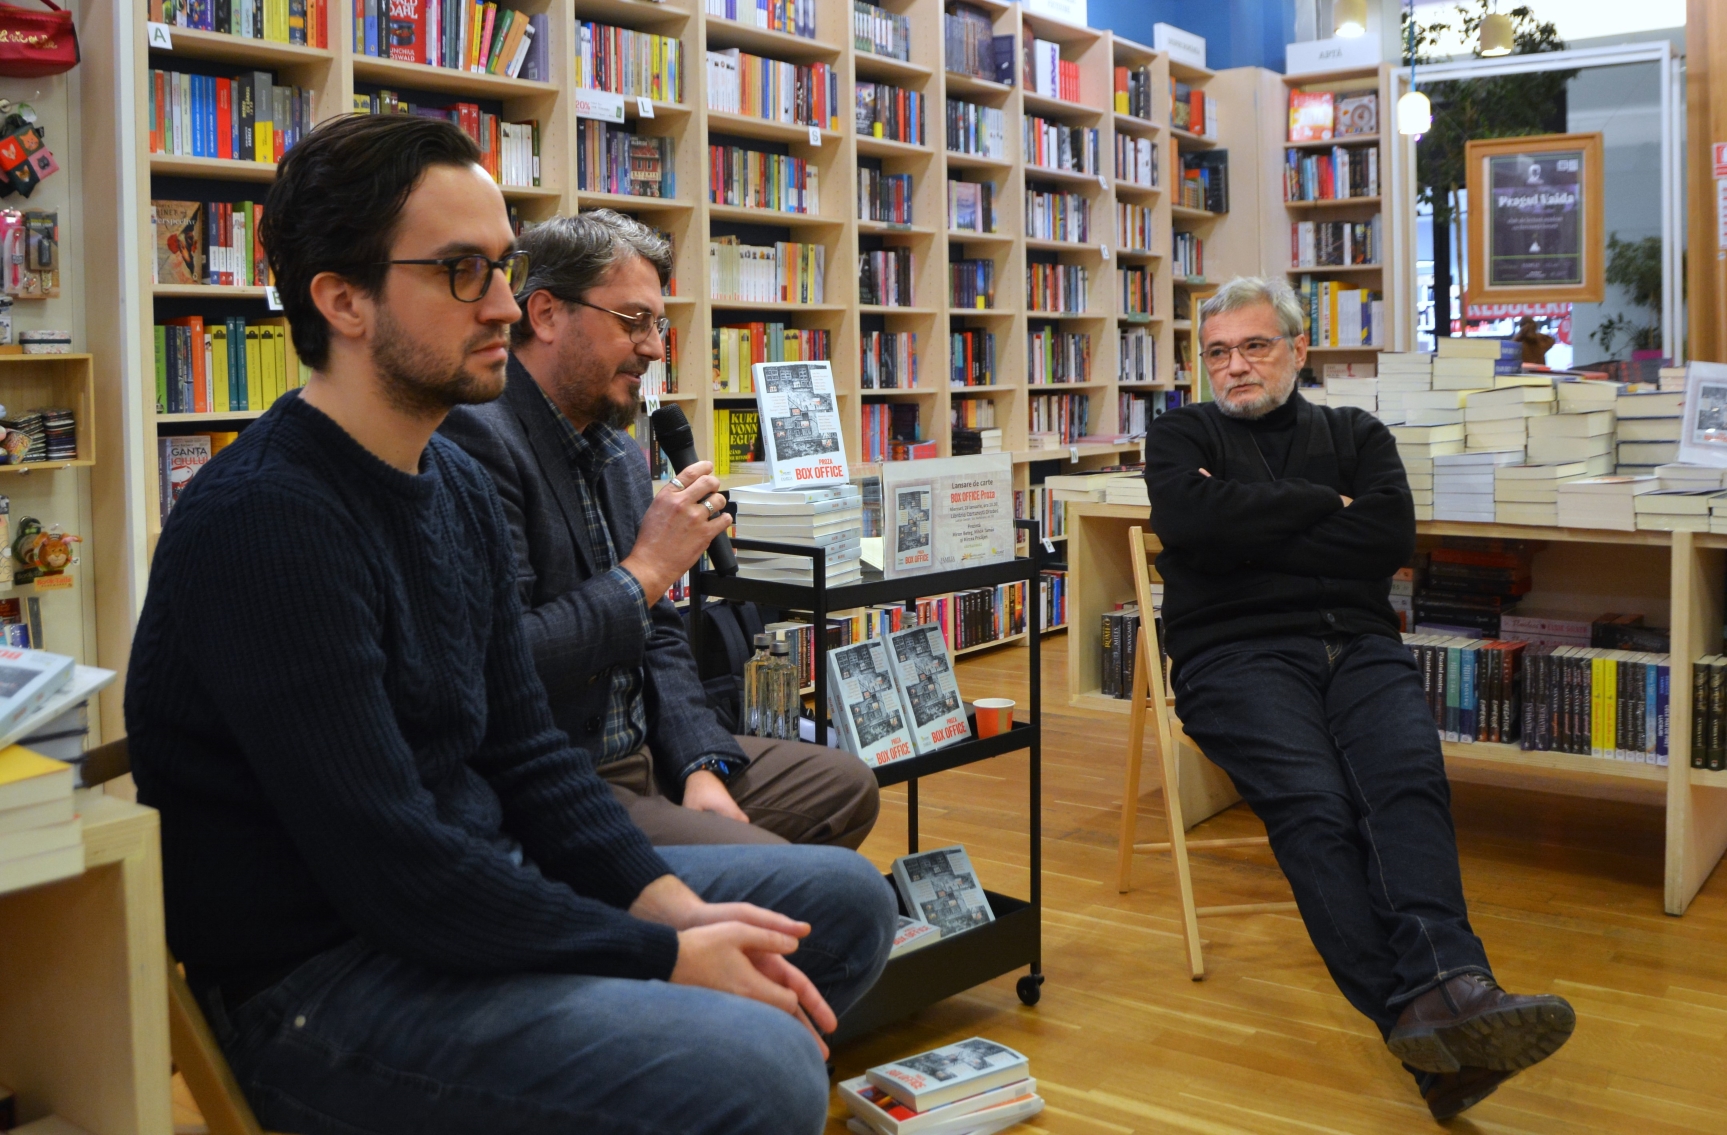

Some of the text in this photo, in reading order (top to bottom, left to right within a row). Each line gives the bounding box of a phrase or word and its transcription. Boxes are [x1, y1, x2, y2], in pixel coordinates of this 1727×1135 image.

[154, 27, 167, 43] A
[641, 101, 649, 113] L
[812, 130, 818, 142] S
[649, 400, 657, 412] M
[731, 413, 758, 423] KURT
[731, 424, 758, 434] VONN
[730, 434, 757, 445] EGUT
[171, 447, 207, 457] GANȚA
[795, 466, 844, 480] BOX OFFICE
[952, 481, 972, 489] Lansare
[980, 479, 993, 487] carte
[951, 490, 995, 503] BOX OFFICE Proza
[905, 554, 929, 564] BOX OFFICE
[931, 721, 967, 744] BOX OFFICE
[876, 741, 911, 765] BOX OFFICE
